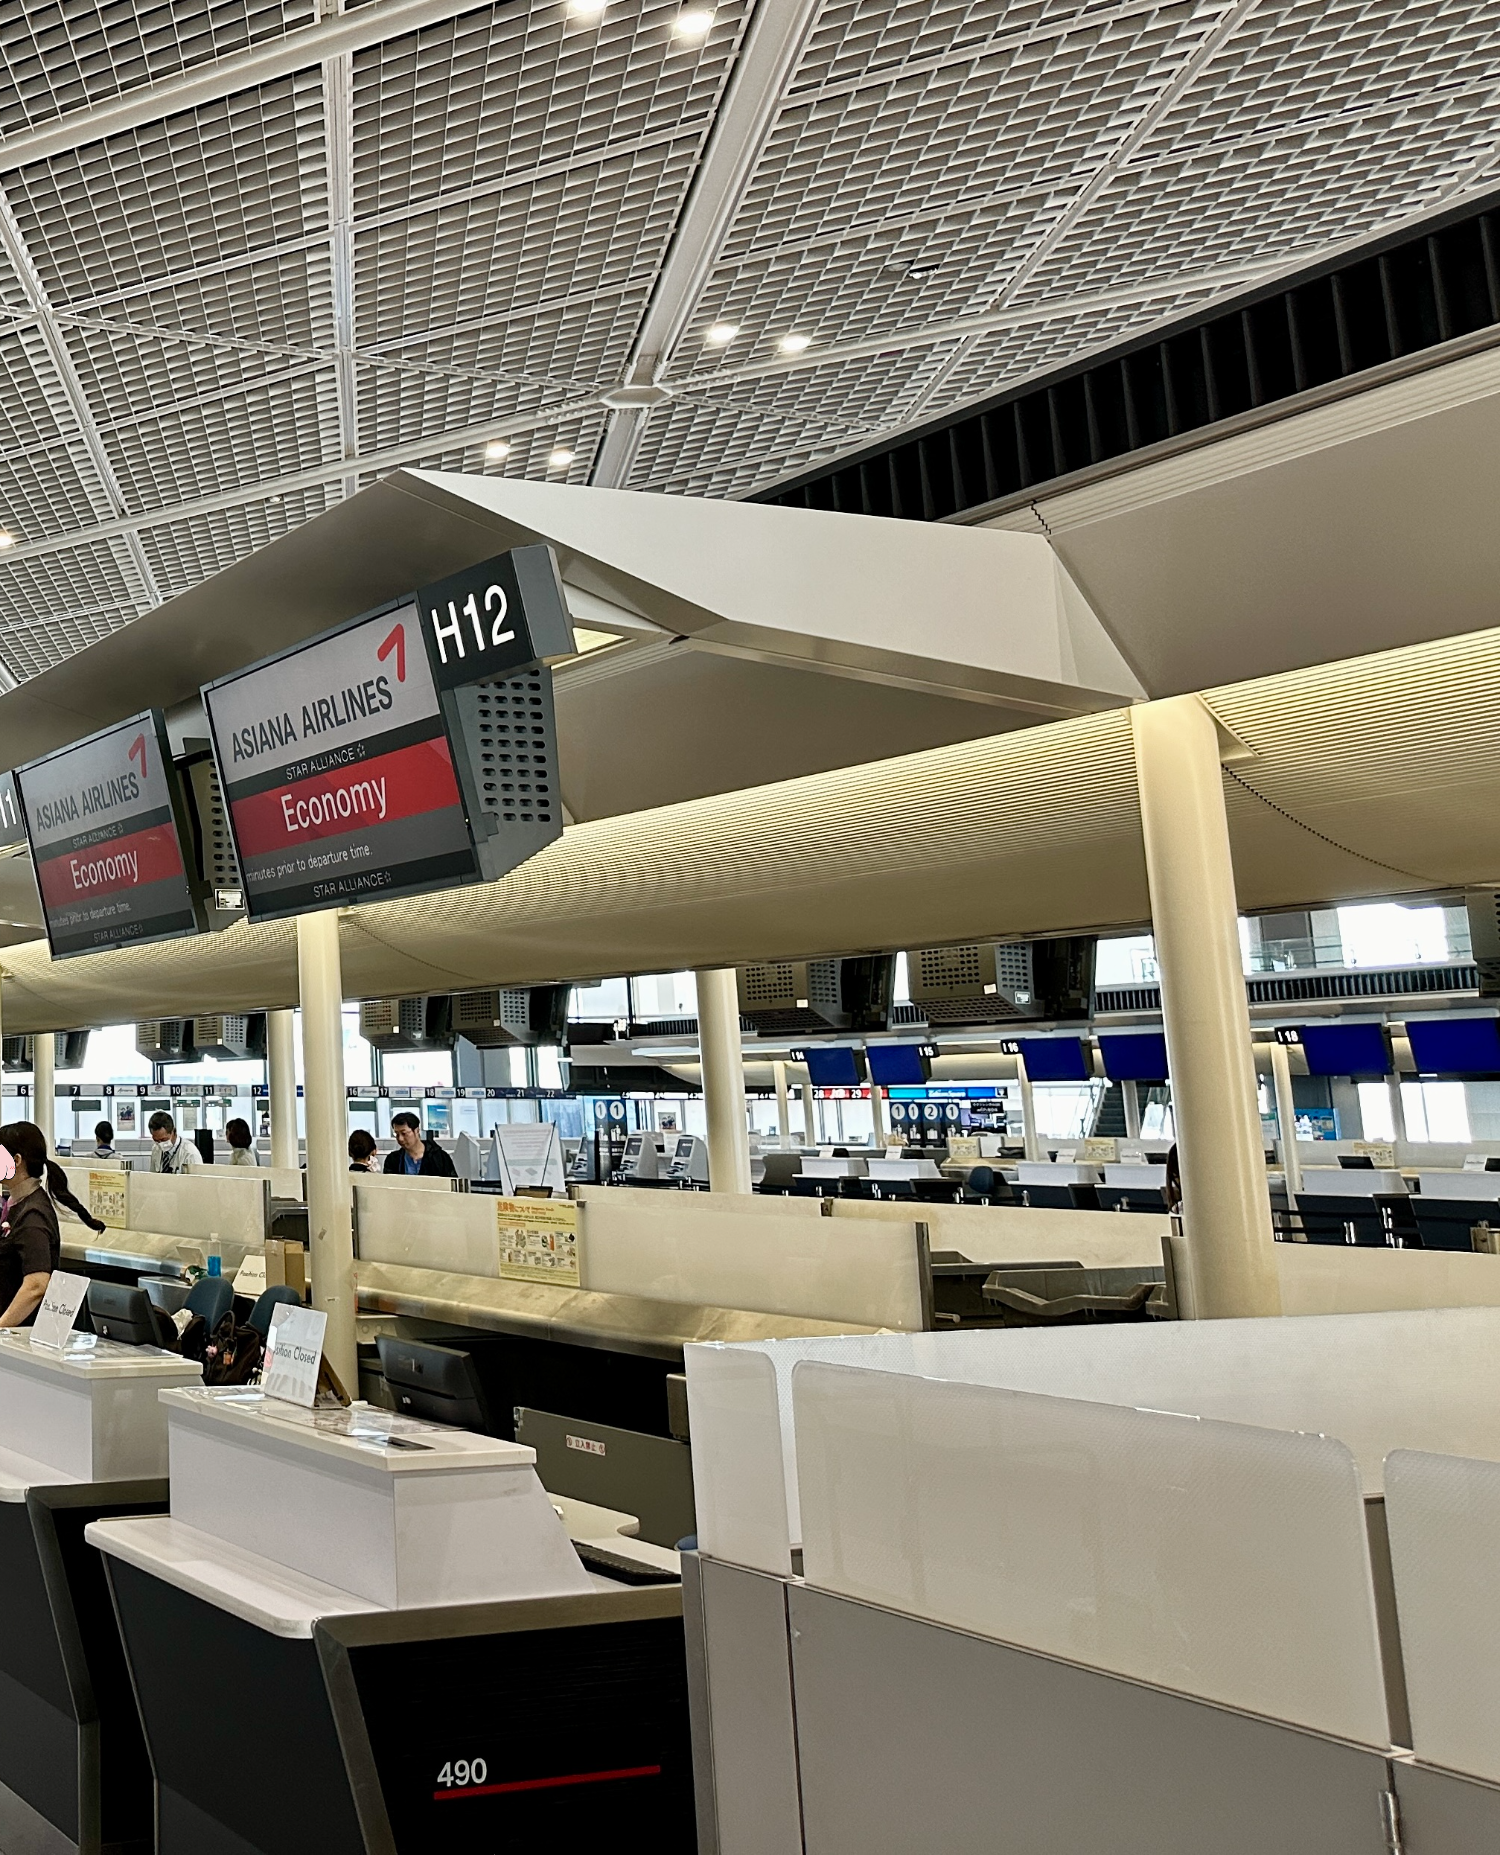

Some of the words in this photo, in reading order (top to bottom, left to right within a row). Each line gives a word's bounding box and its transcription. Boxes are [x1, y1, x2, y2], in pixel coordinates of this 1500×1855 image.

[431, 584, 515, 664] H12
[232, 712, 297, 763] ASIANA
[302, 675, 393, 739] AIRLINES
[286, 762, 308, 780] STAR
[310, 747, 356, 773] ALLIANCE
[36, 795, 80, 832] ASIANA
[81, 771, 140, 816] AIRLINES
[281, 776, 387, 832] Economy
[72, 834, 87, 849] STAR
[88, 825, 117, 846] ALLIANCE
[277, 860, 295, 879] prior
[296, 857, 306, 872] to
[308, 849, 348, 870] departure
[350, 843, 373, 861] time.
[70, 850, 139, 890] Economy
[313, 882, 336, 899] STAR
[338, 872, 385, 894] ALLIANCE
[93, 930, 109, 943] STAR
[110, 925, 139, 941] ALLIANCE
[20, 1086, 26, 1094] 6
[72, 1086, 78, 1095] 7
[106, 1086, 112, 1094] 8
[140, 1086, 145, 1094] 9
[172, 1086, 181, 1095] 10
[204, 1086, 213, 1094] 11
[253, 1086, 262, 1095] 12
[349, 1088, 357, 1096] 16
[380, 1088, 388, 1096] 17
[426, 1088, 435, 1096] 18
[457, 1088, 465, 1097] 19
[486, 1088, 495, 1097] 20
[516, 1089, 524, 1097] 21
[546, 1090, 555, 1098] 22
[851, 1089, 862, 1099] 29
[273, 1344, 292, 1359] sition
[294, 1346, 317, 1365] Closed
[437, 1757, 487, 1787] 490
